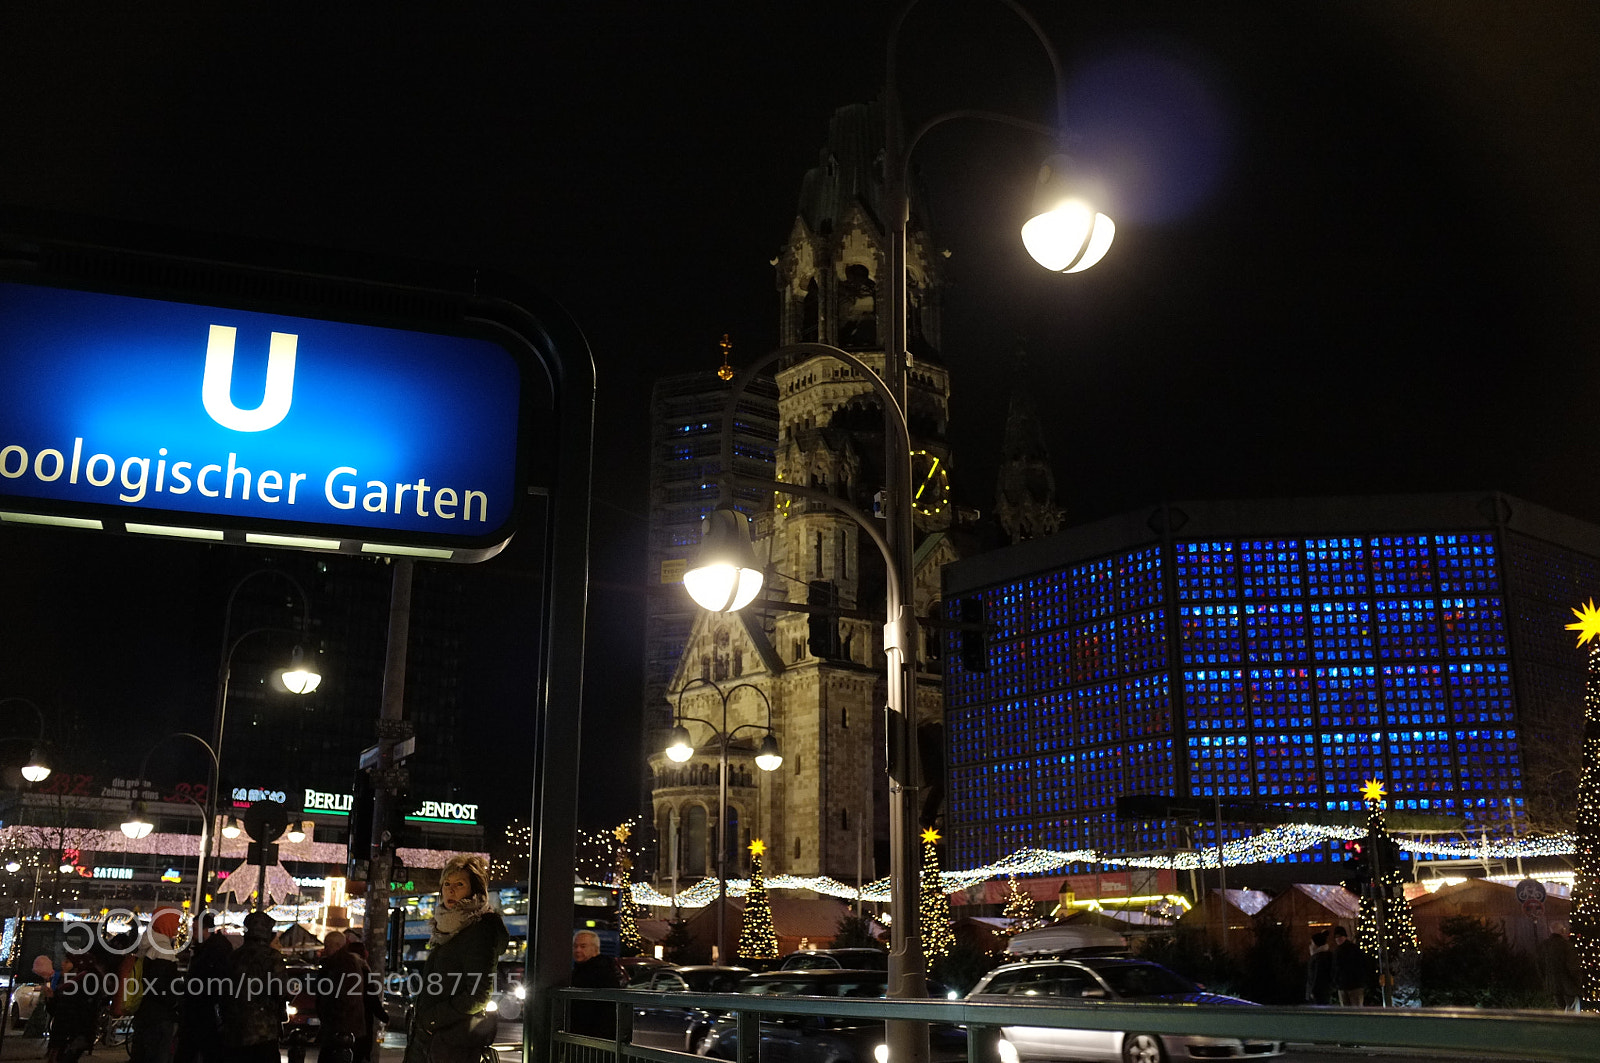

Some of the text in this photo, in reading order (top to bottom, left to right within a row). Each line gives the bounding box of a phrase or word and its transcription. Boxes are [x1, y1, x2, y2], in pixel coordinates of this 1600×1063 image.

[201, 324, 299, 433] U
[0, 436, 488, 522] oologischer Garten
[132, 789, 160, 801] Brlins
[93, 866, 134, 880] SATURN
